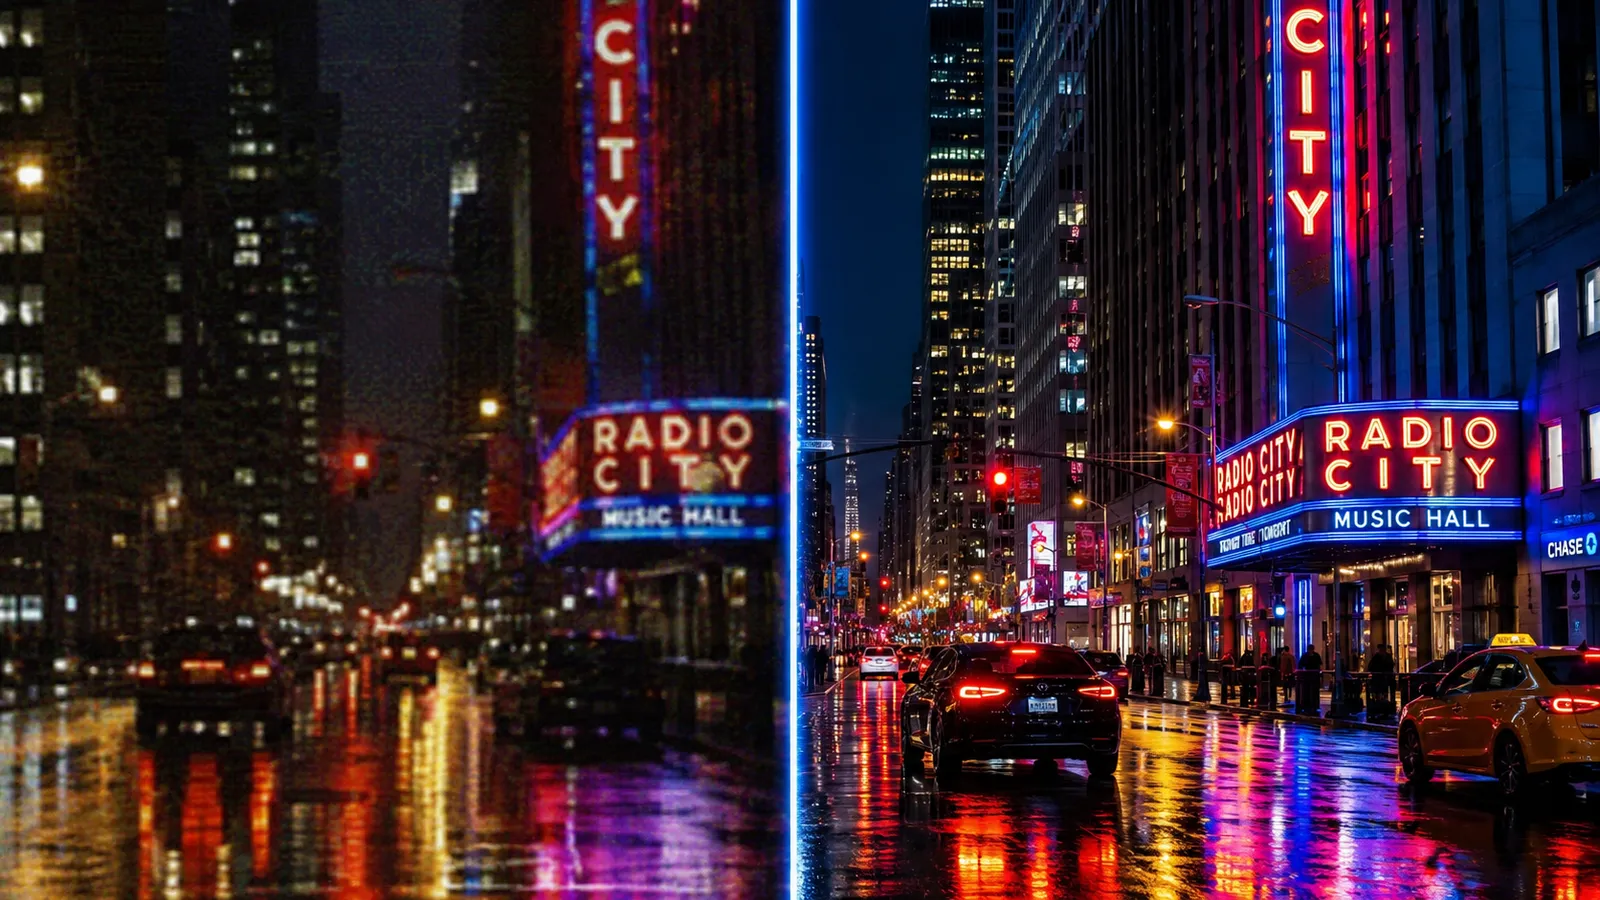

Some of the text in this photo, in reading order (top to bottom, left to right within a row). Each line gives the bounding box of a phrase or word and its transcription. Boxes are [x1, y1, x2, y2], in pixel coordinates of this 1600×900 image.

[595, 20, 637, 240] CITY
[1286, 9, 1329, 235] CITY
[593, 414, 752, 453] RADIO
[1325, 416, 1498, 452] RADIO
[593, 454, 750, 491] CITY
[1217, 451, 1254, 494] RADIO
[1259, 428, 1295, 475] CITY
[1325, 456, 1496, 492] CITY
[1259, 467, 1295, 508] CITY
[602, 504, 744, 527] MUSIC HALL
[1334, 509, 1490, 529] MUSIC HALL
[1547, 537, 1583, 558] CHASE
